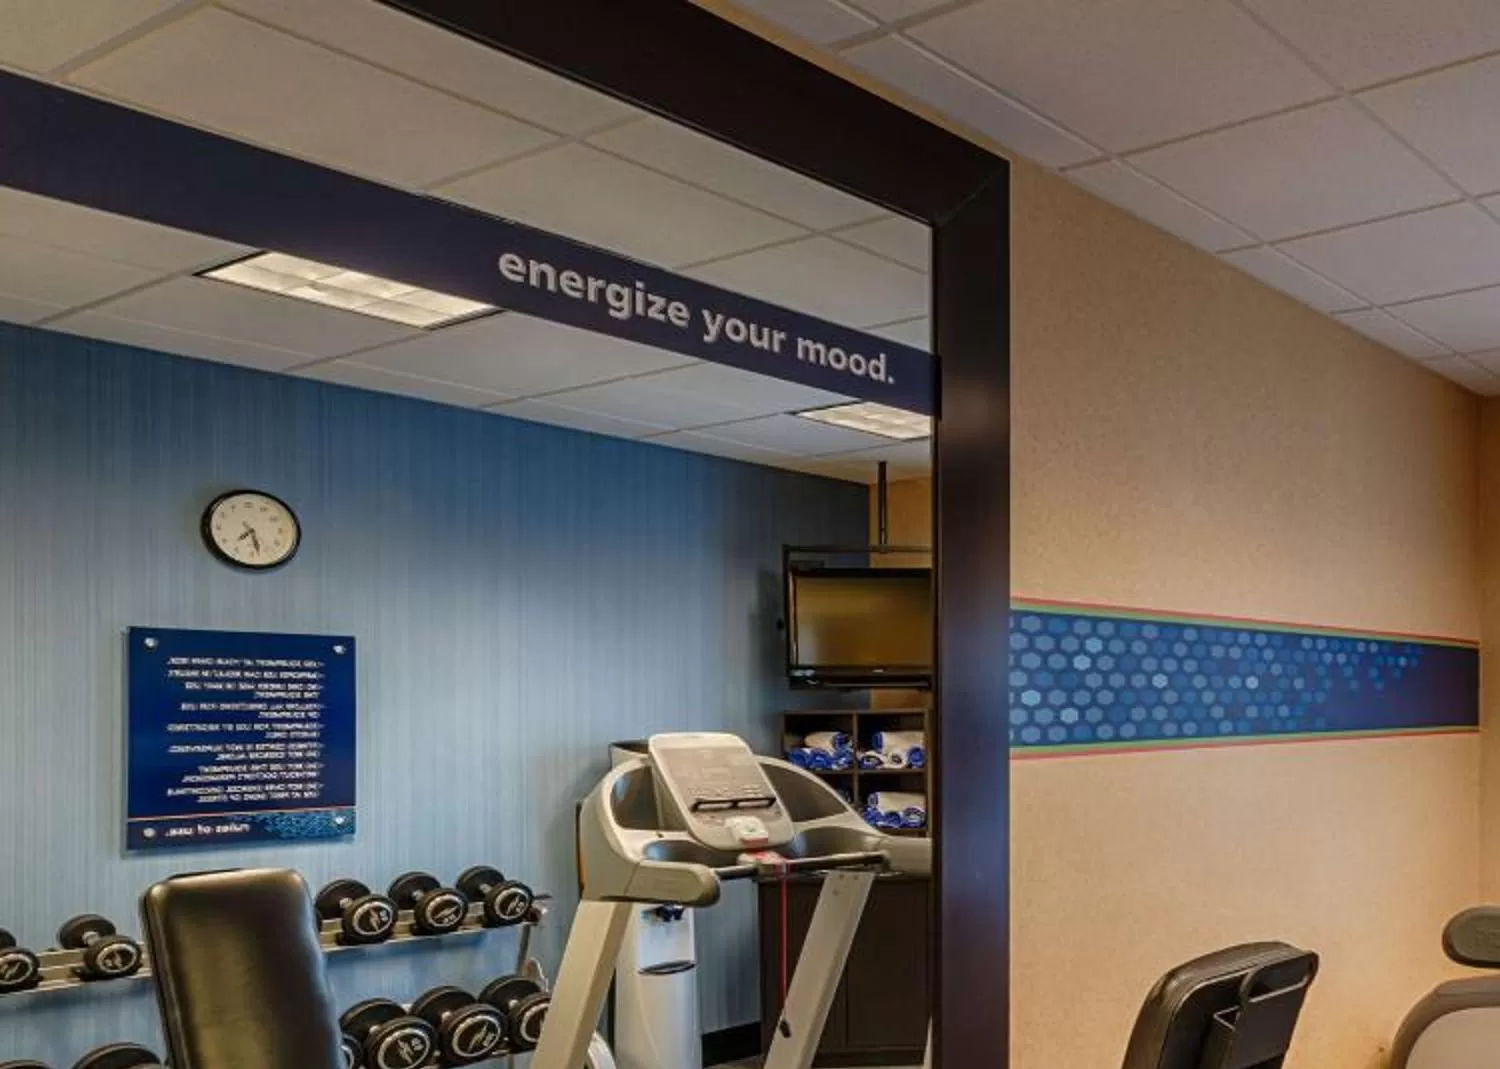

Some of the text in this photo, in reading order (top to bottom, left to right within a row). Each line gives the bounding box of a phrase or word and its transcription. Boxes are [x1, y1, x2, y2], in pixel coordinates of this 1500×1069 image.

[498, 252, 896, 384] energize your mood.
